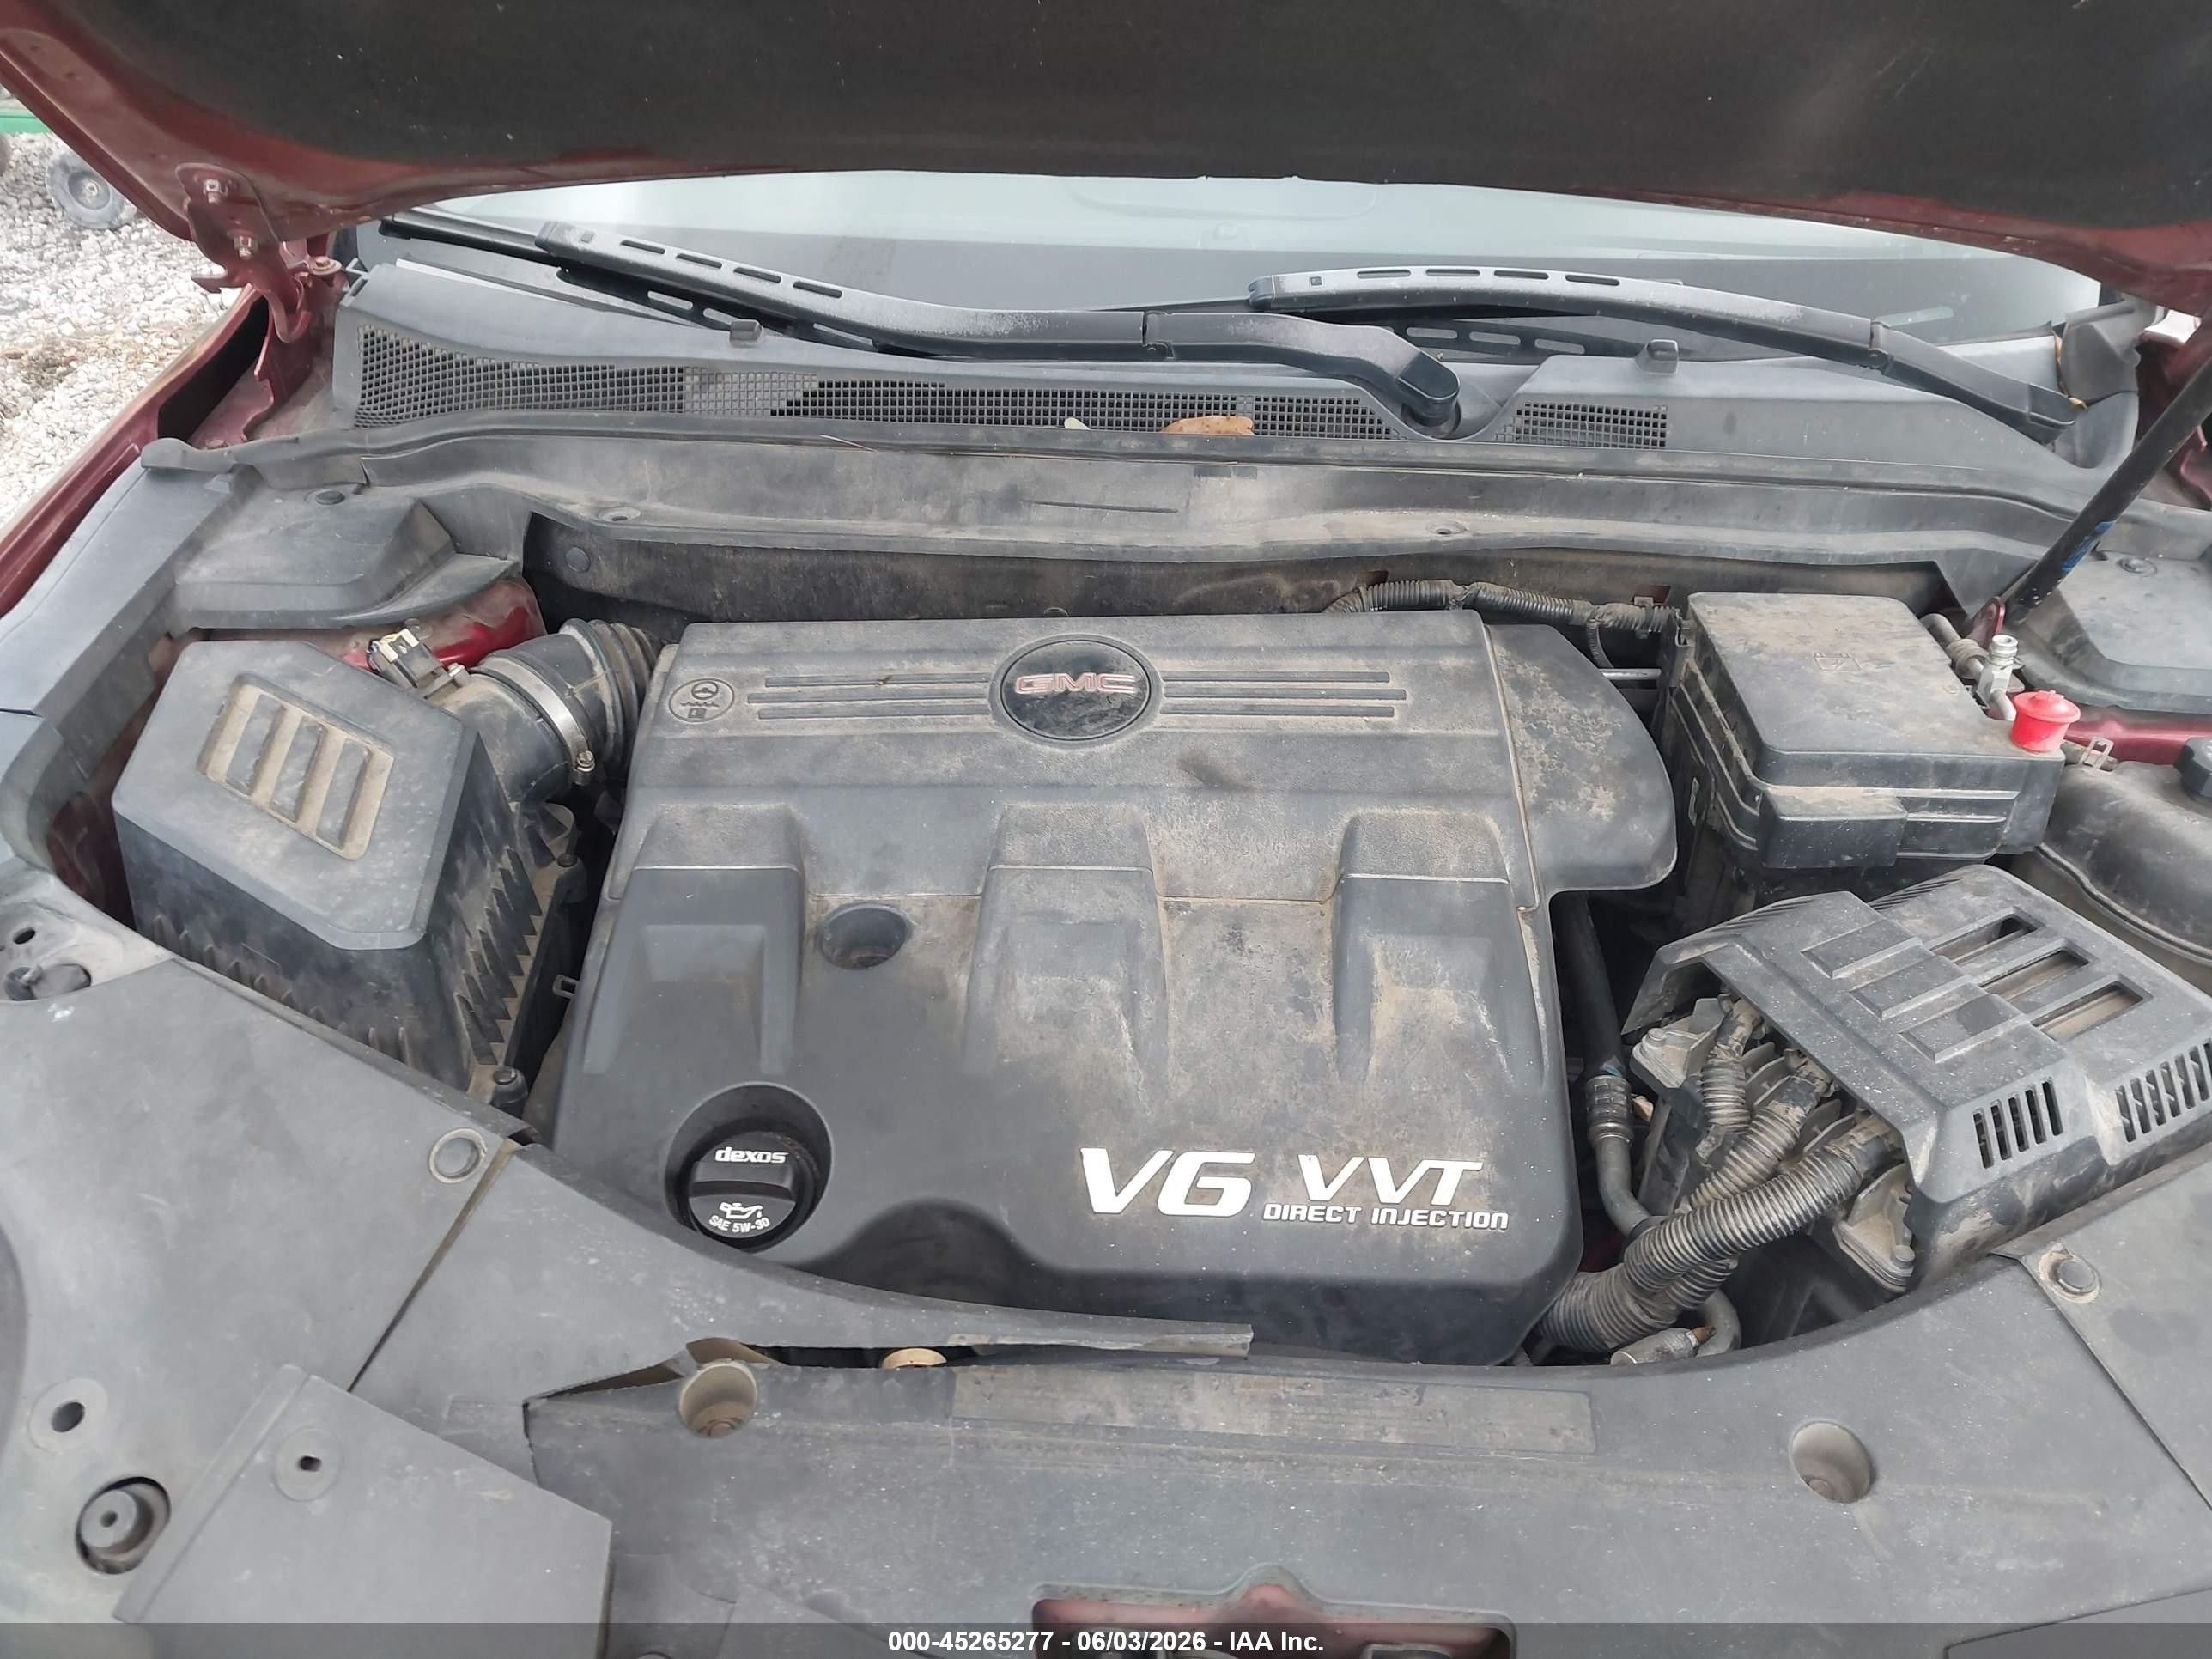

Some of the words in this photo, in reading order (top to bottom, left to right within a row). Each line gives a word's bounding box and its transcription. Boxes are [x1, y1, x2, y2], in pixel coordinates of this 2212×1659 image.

[1016, 672, 1135, 695] GMC
[714, 1146, 789, 1164] dexos
[1080, 1147, 1255, 1218] V6
[1297, 1154, 1484, 1206] VVT
[708, 1215, 731, 1231] SAE
[732, 1217, 770, 1233] 5W-30
[1263, 1203, 1362, 1224] DIRECT
[1371, 1206, 1510, 1230] INJECTION
